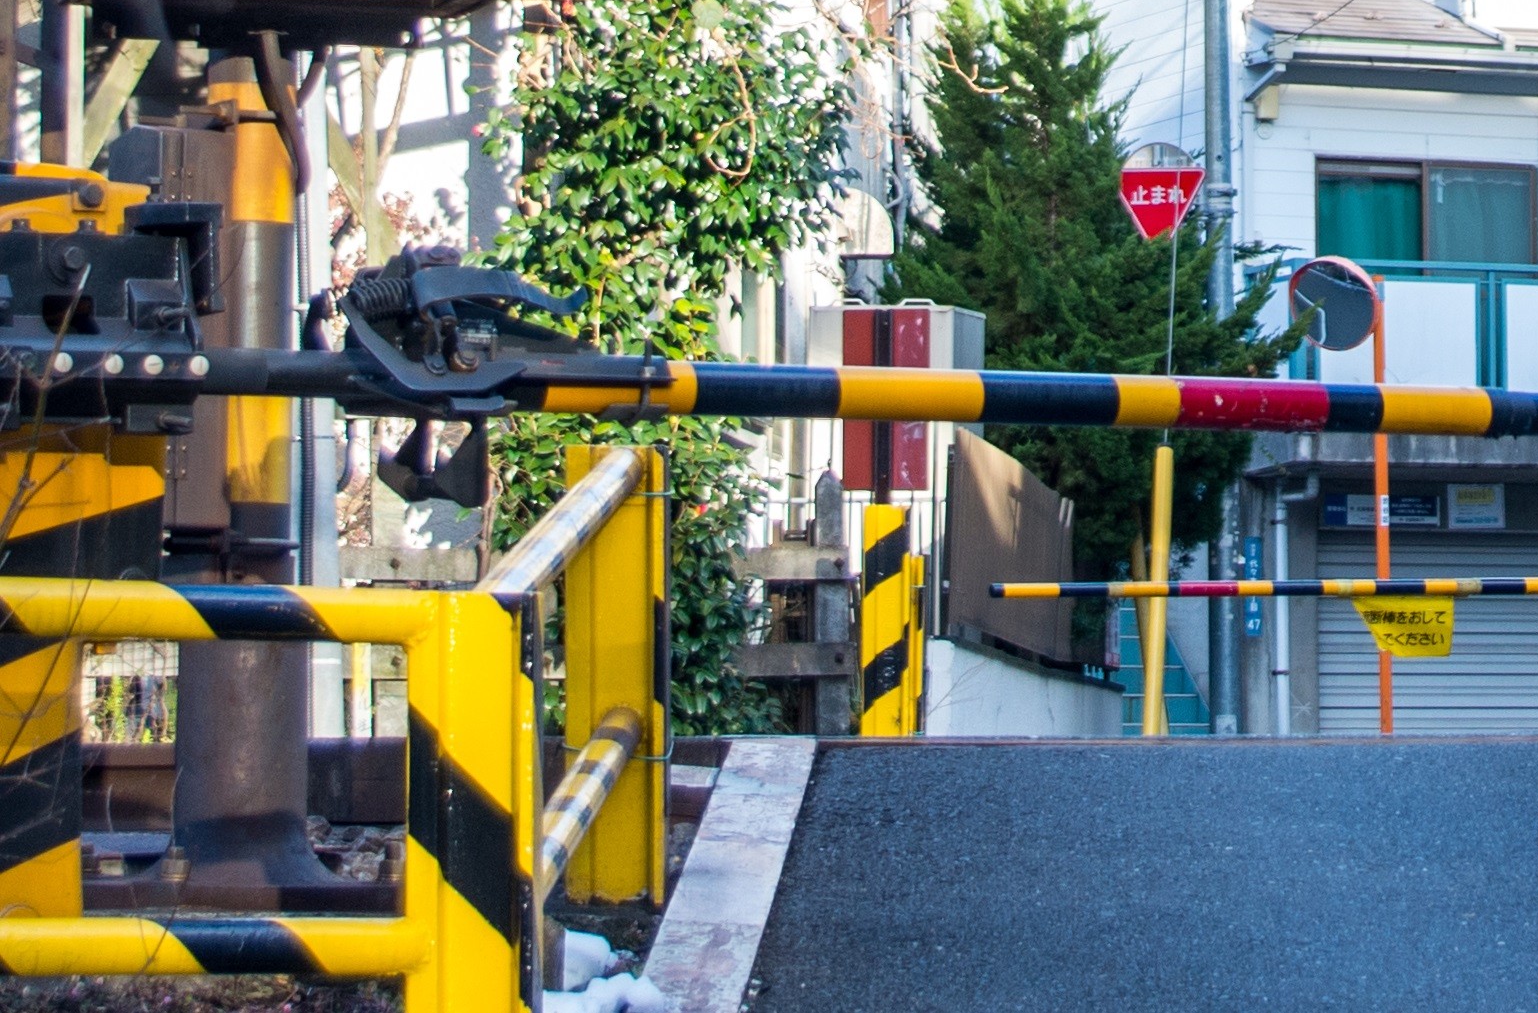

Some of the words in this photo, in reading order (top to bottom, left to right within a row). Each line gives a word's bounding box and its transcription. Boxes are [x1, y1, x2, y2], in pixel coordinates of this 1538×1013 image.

[1130, 184, 1188, 205] 止まれ
[1247, 619, 1261, 631] 47
